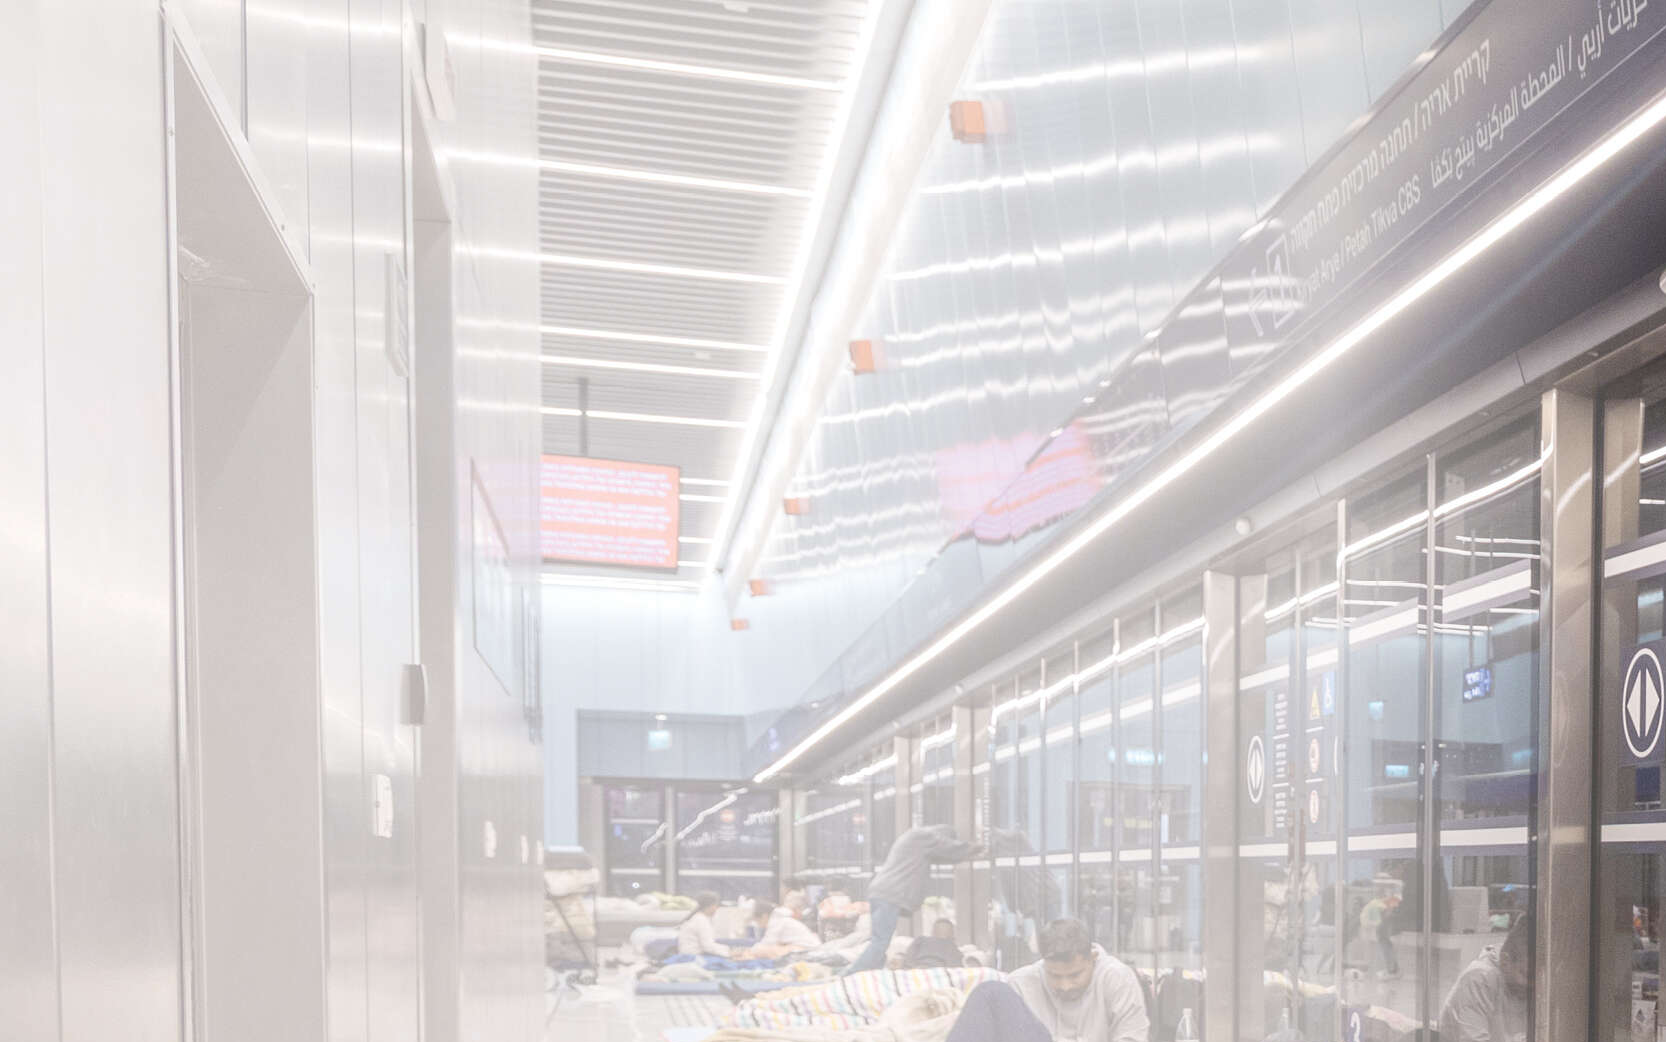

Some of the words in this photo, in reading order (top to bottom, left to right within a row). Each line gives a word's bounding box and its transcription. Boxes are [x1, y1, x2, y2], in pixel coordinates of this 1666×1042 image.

[1608, 0, 1649, 34] ريات
[1453, 39, 1490, 101] קריית
[1520, 44, 1566, 110] المحطة
[1420, 79, 1452, 131] אריה
[1476, 86, 1519, 151] المركزية
[1380, 117, 1412, 169] תחנה
[1398, 175, 1421, 215] CBS
